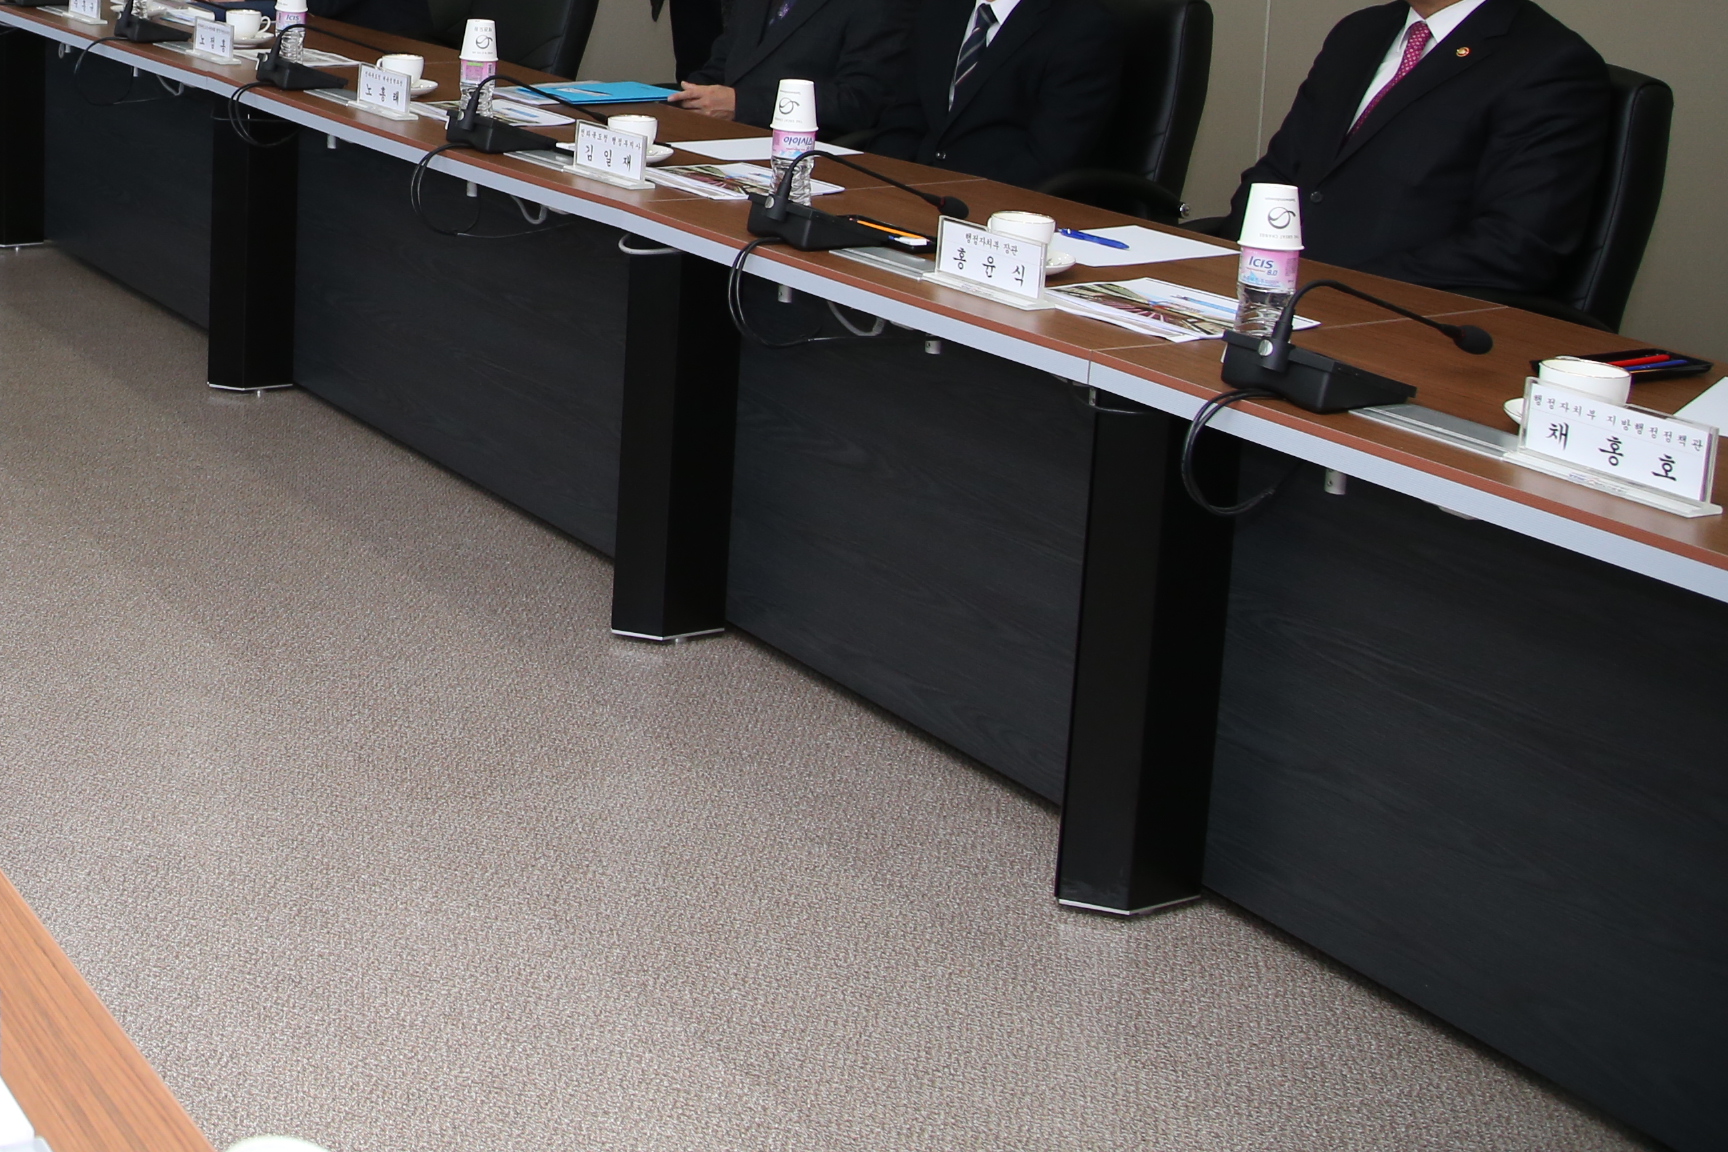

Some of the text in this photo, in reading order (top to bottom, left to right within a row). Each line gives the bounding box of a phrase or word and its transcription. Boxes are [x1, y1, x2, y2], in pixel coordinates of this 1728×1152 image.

[965, 232, 1019, 257] 행정자치부 장관
[953, 246, 1026, 287] 홍윤식
[1248, 255, 1274, 269] ICIS
[1266, 269, 1279, 277] 8.0
[1533, 394, 1704, 452] 행정자치부 지방행정정책관
[1546, 421, 1677, 482] 채홍호
